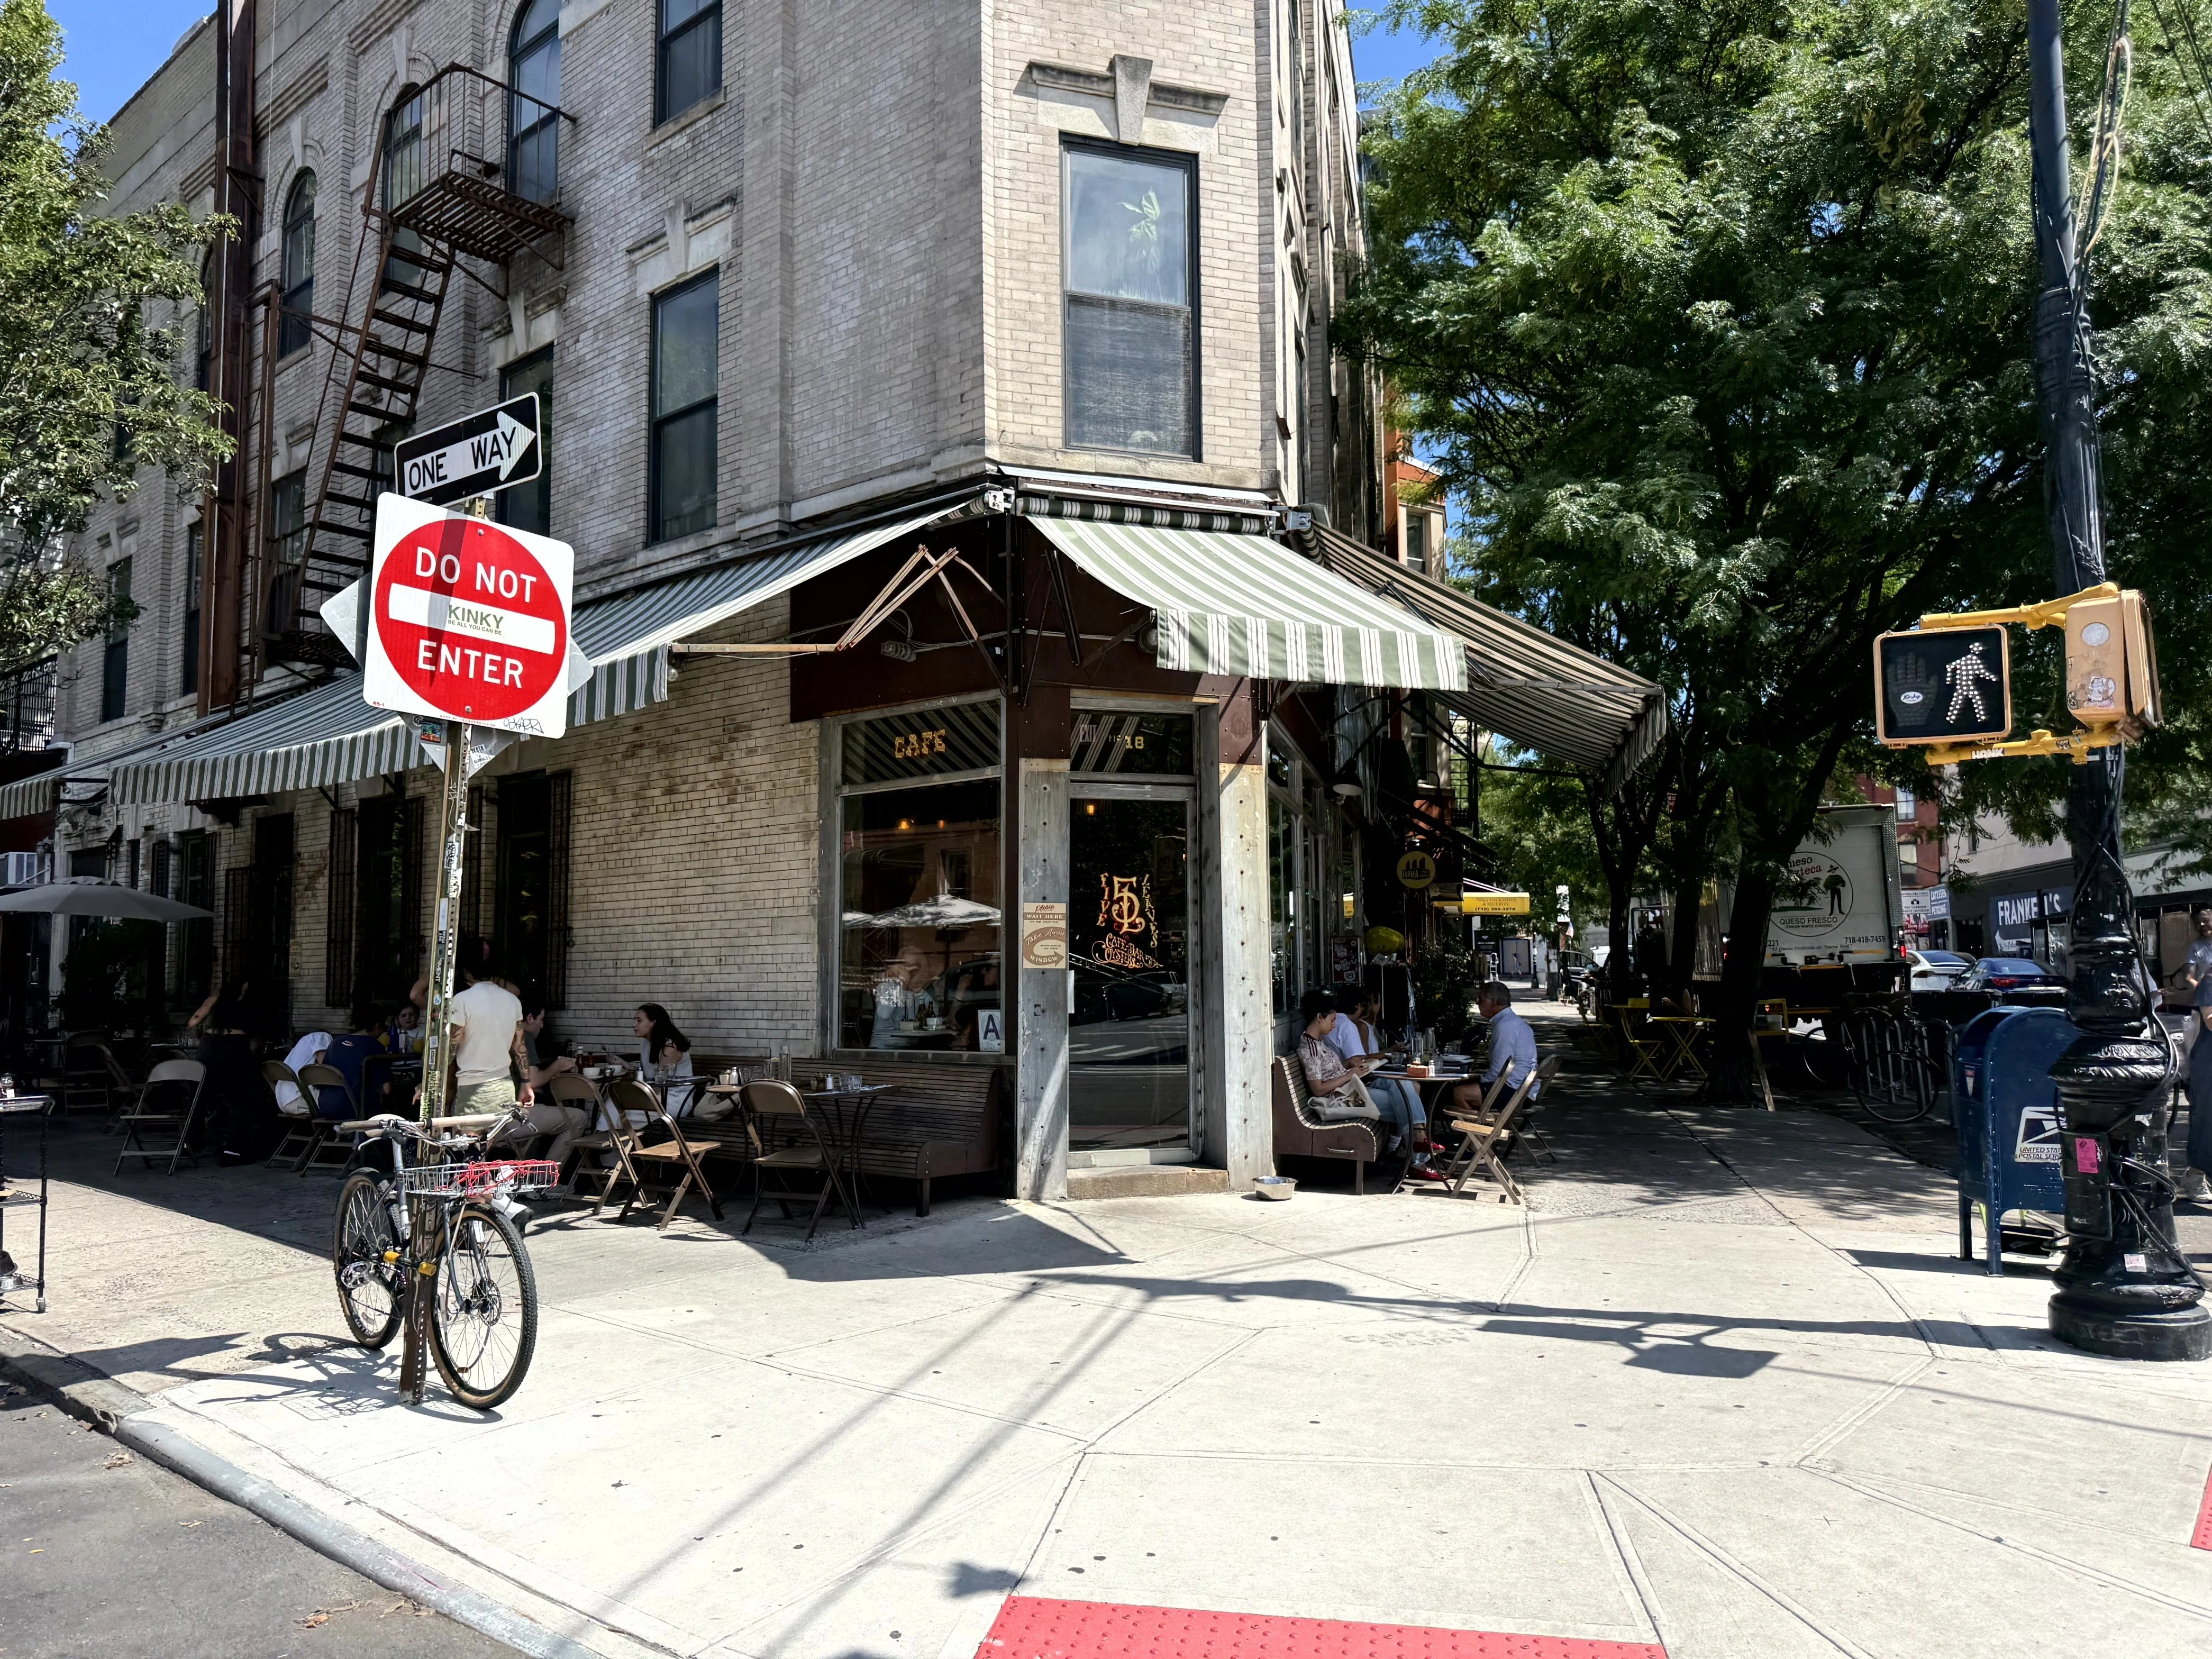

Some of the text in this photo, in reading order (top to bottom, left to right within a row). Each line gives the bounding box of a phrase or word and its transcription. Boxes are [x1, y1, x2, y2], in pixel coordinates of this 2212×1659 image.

[409, 426, 517, 491] ONE WAY
[415, 546, 537, 603] DO NOT
[448, 604, 504, 629] KINKY
[417, 640, 523, 688] ENTER
[895, 729, 945, 759] CAFE
[1079, 724, 1097, 743] EXIT
[1972, 747, 2005, 760] HANK
[1788, 855, 1813, 868] ueso
[1794, 864, 1822, 877] zteca
[1403, 870, 1419, 878] FORMA
[1141, 873, 1159, 948] LEAVES
[1844, 935, 1886, 944] 718-418-7459
[1030, 954, 1058, 963] WINDOW
[1104, 947, 1137, 969] OYSTERS
[983, 1014, 1000, 1040] A
